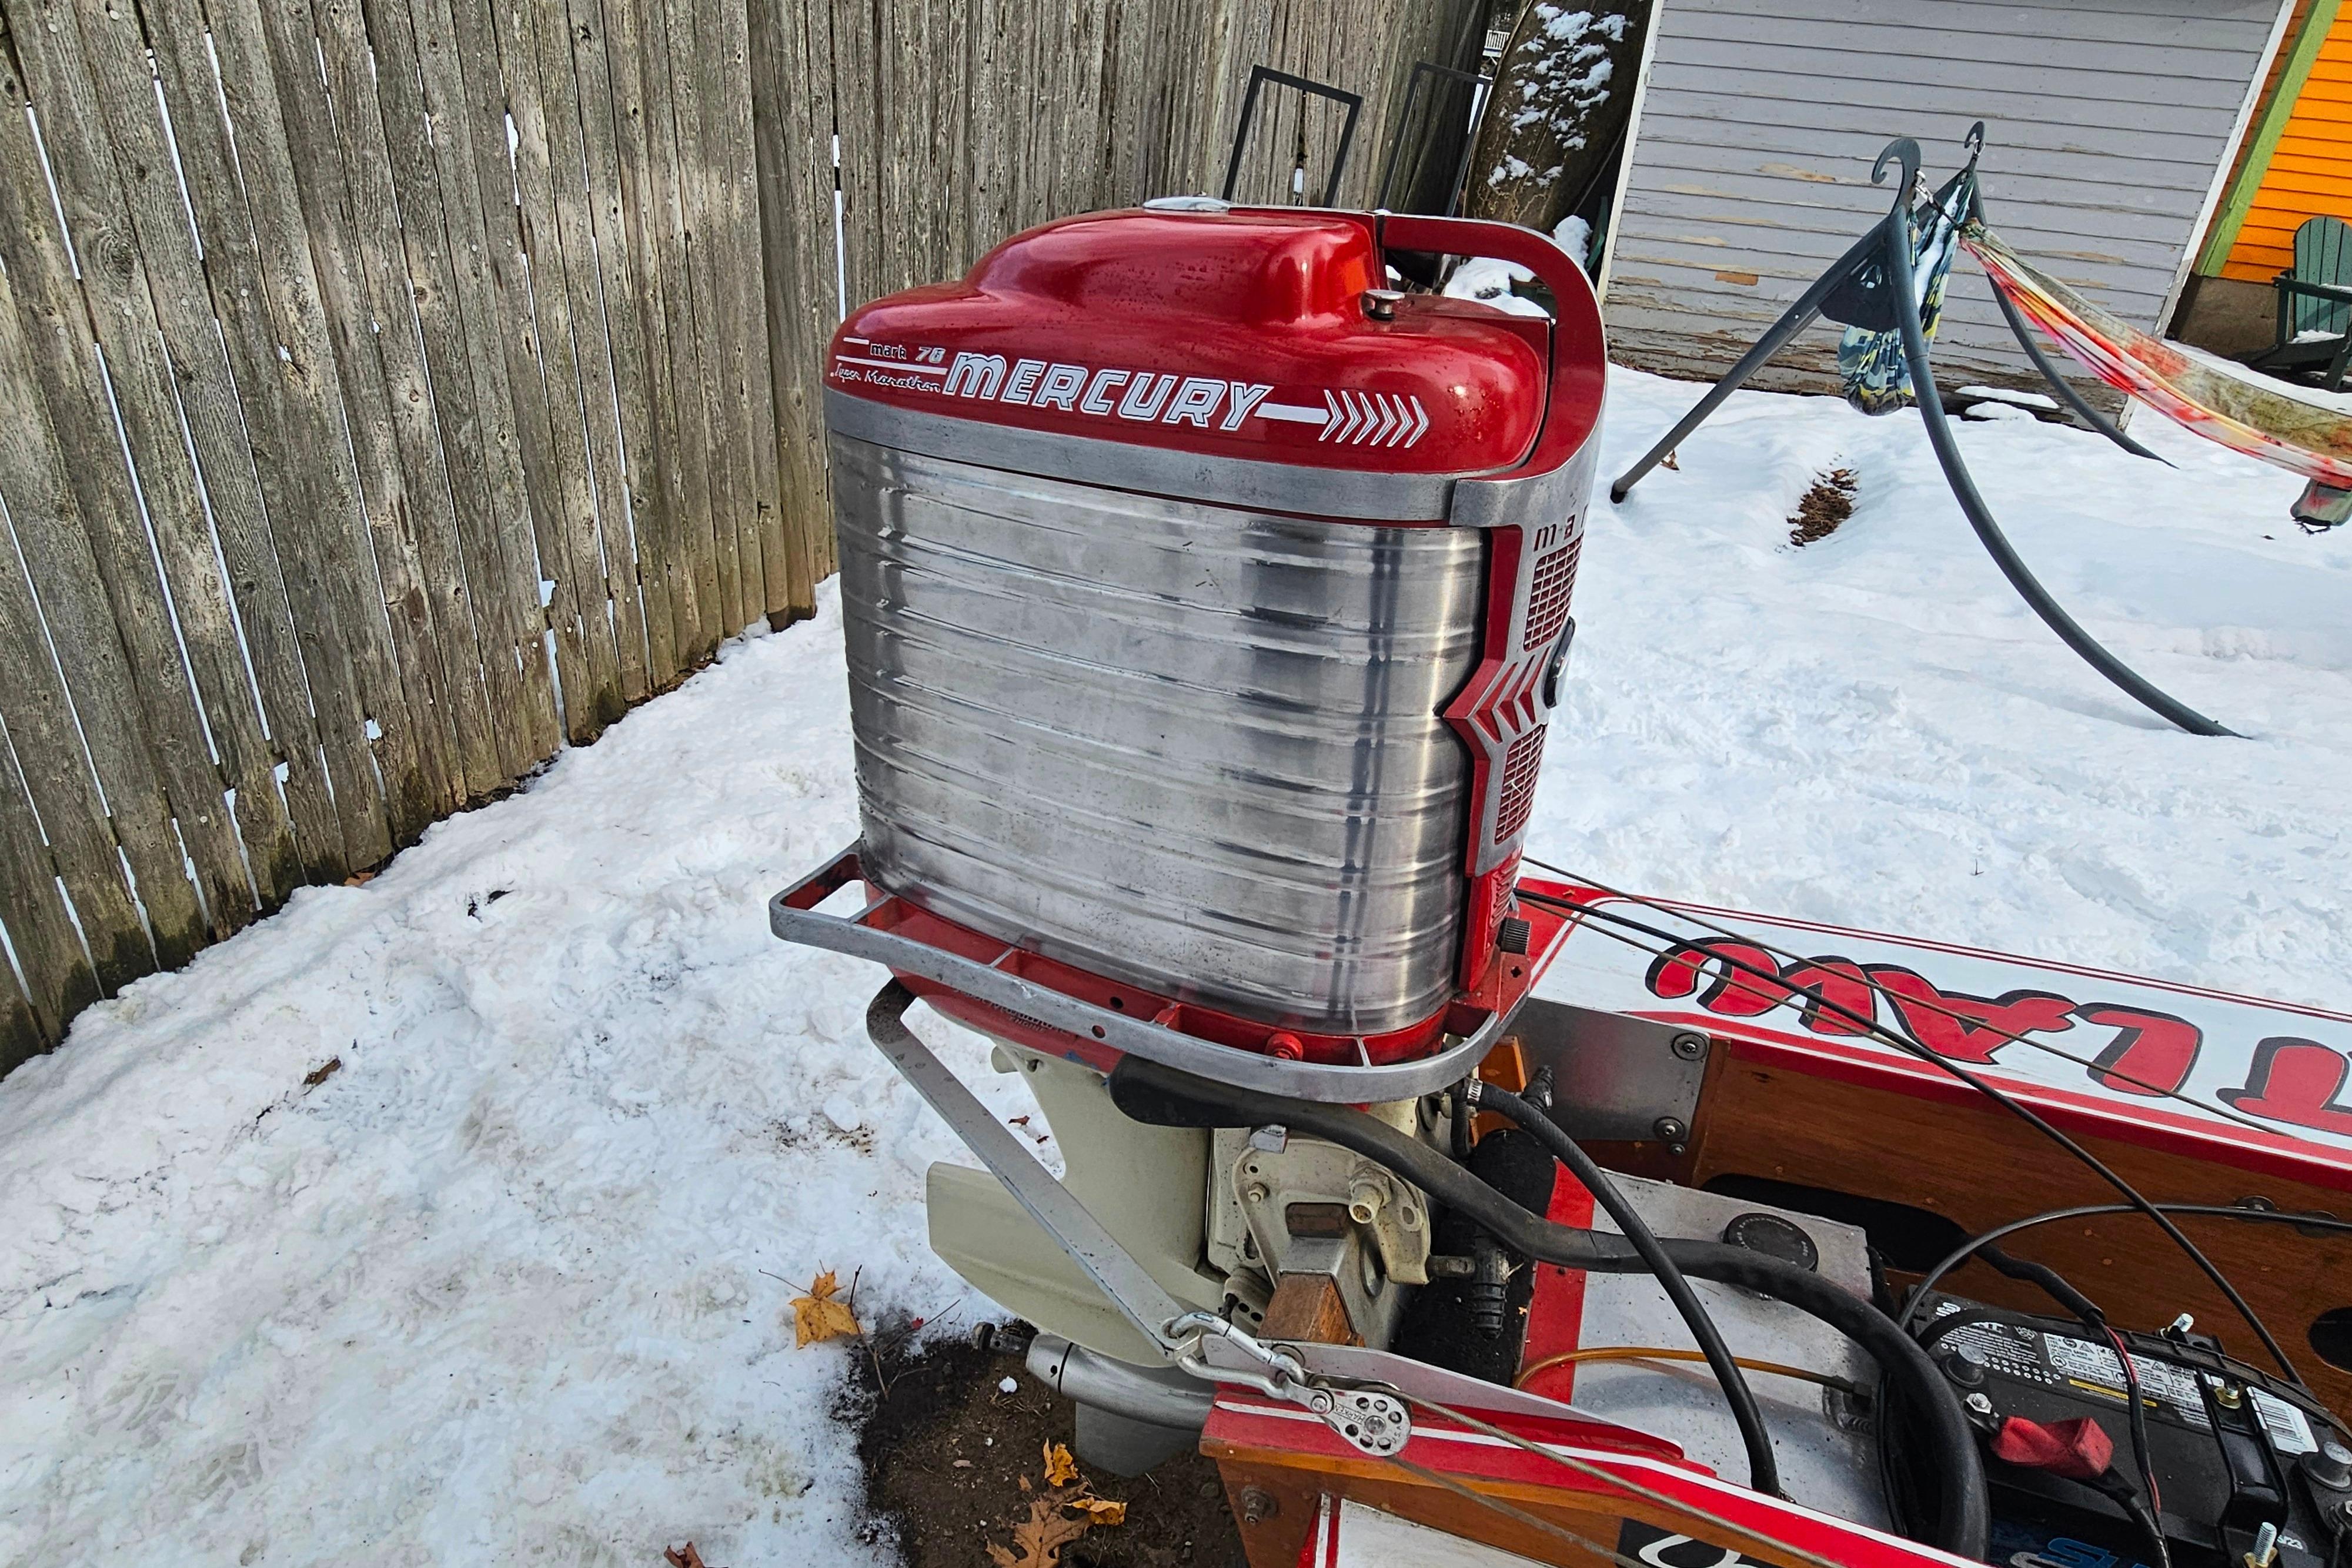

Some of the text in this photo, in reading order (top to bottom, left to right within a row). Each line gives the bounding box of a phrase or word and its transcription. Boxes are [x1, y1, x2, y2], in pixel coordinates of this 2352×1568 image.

[870, 343, 907, 360] mark
[830, 362, 941, 393] Super Marathon
[942, 352, 1274, 432] MERCURY
[1645, 937, 2352, 1135] TLAW
[1335, 1403, 1366, 1424] HARKEN
